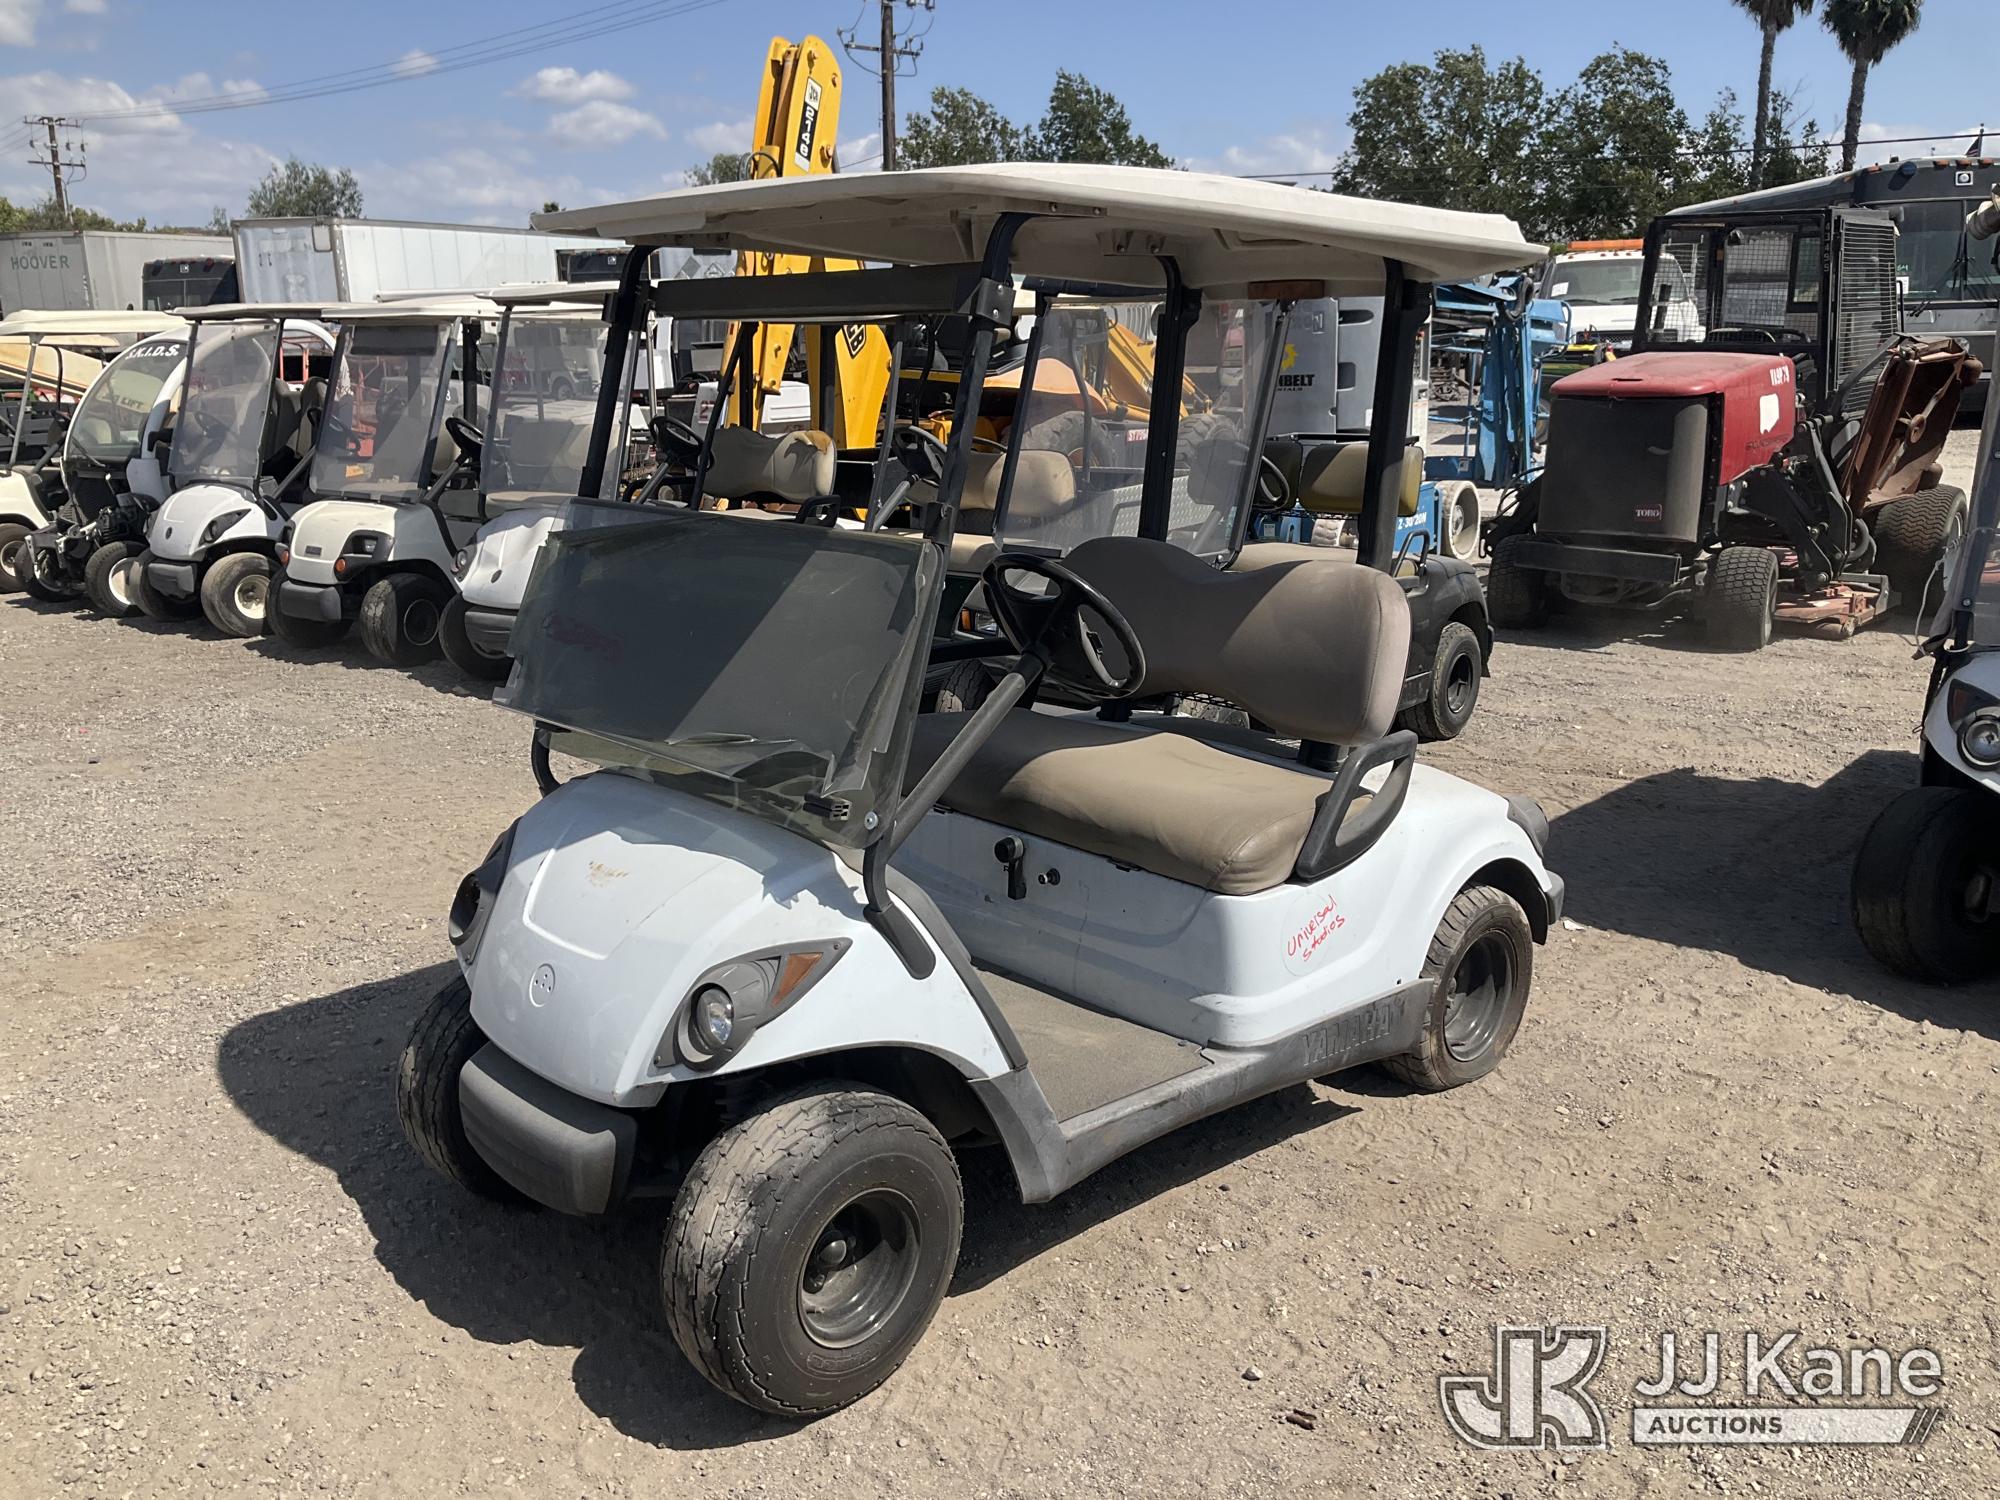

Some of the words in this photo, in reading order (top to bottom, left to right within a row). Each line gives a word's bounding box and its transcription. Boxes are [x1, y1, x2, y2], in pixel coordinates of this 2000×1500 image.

[10, 255, 70, 270] HOOVER
[1635, 509, 1660, 517] TORO
[1287, 894, 1337, 957] Universal
[1302, 1004, 1391, 1067] YAMAHA
